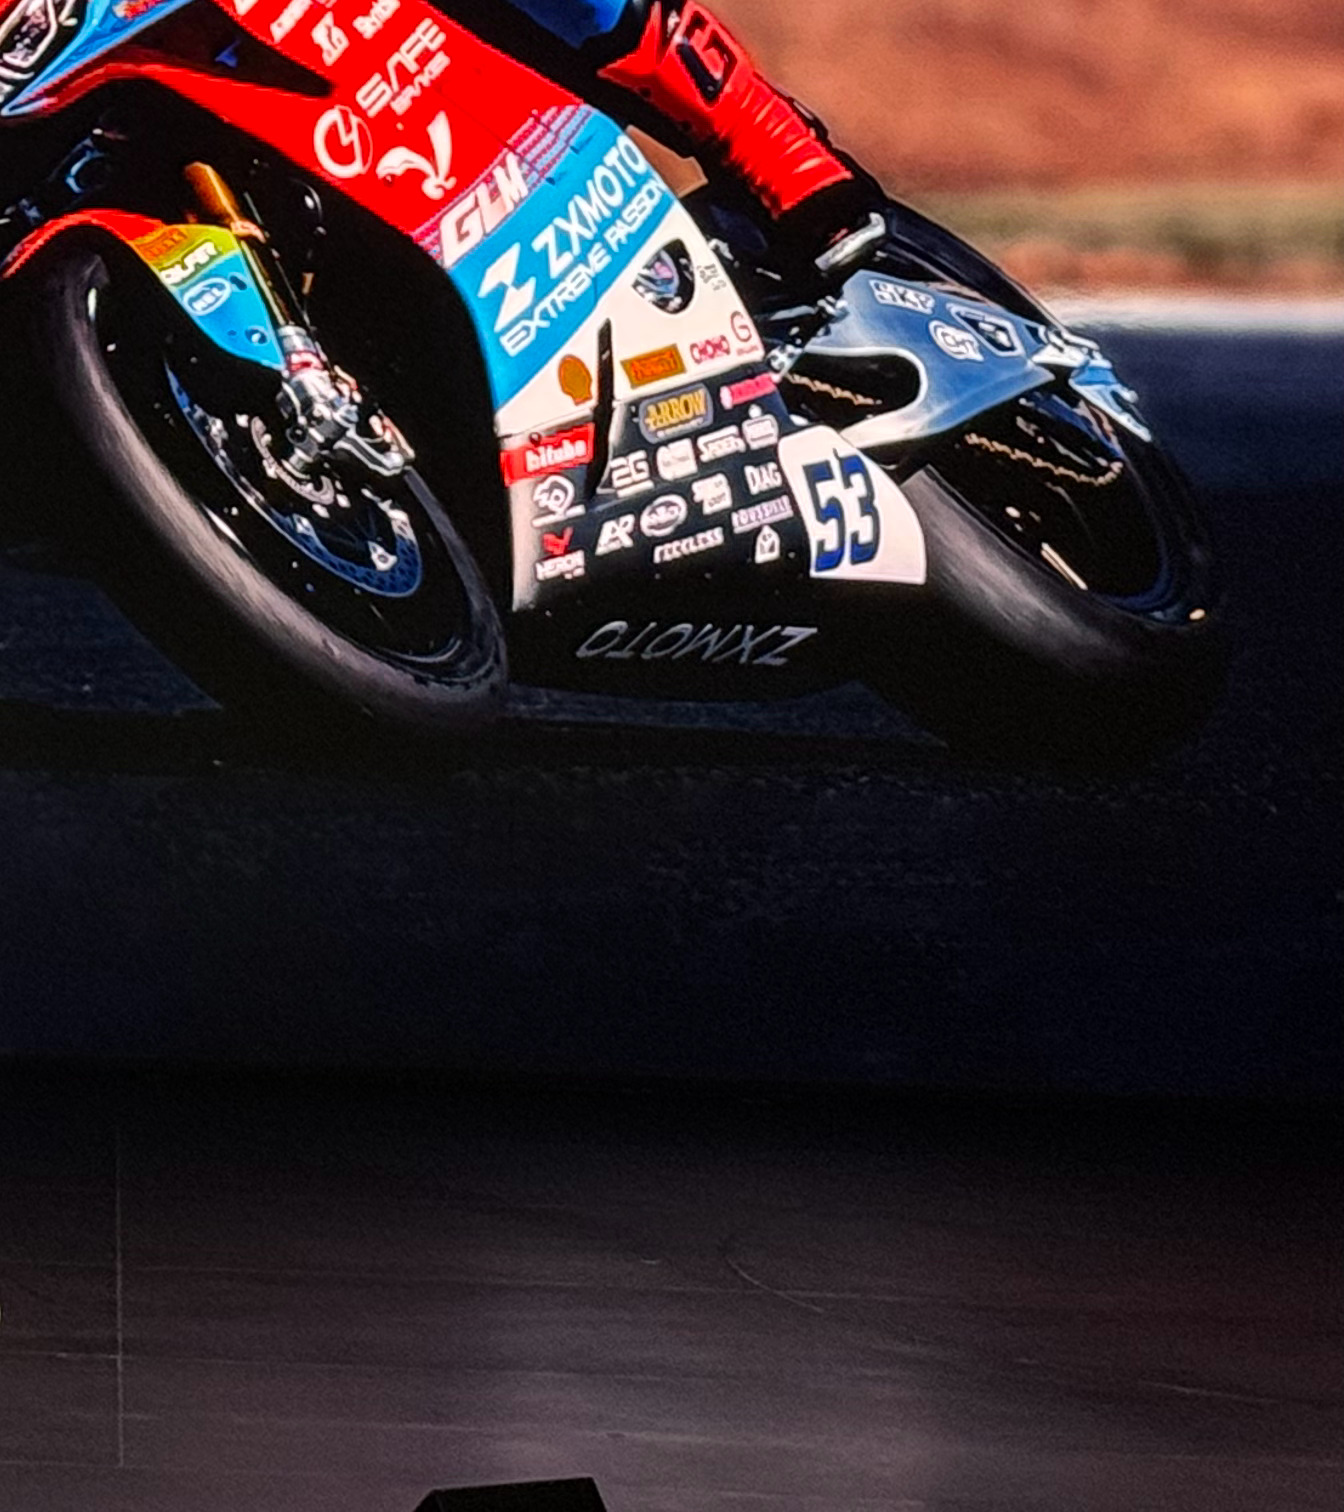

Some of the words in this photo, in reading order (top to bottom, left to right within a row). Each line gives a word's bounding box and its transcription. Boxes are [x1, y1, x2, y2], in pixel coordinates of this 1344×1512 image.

[439, 150, 530, 271] GLM
[531, 133, 650, 281] ZXMOTO
[801, 453, 881, 573] 53
